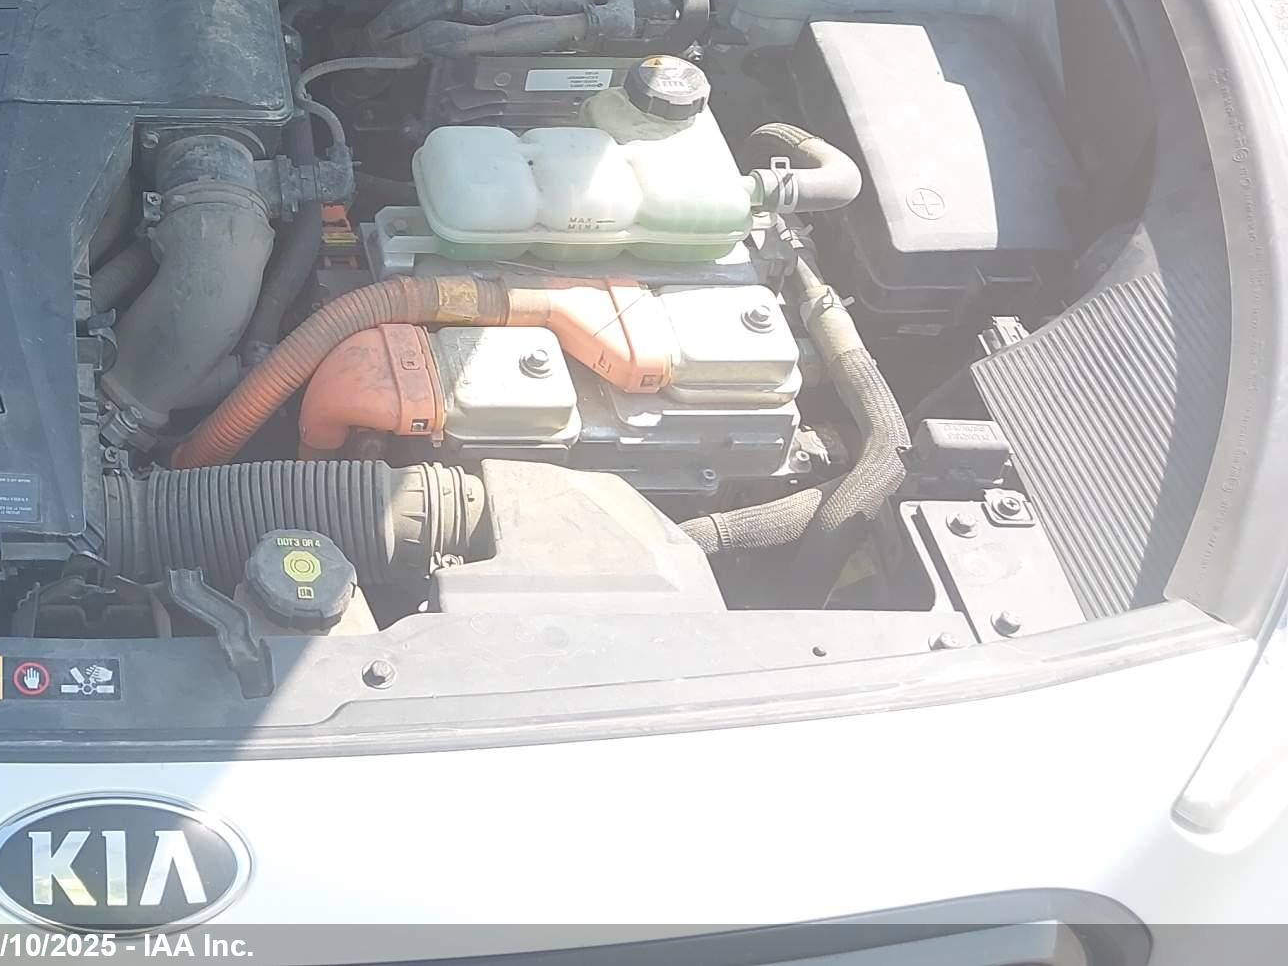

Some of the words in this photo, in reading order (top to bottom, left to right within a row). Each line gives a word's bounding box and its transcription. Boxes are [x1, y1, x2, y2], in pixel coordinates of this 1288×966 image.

[276, 537, 300, 547] DOT3
[301, 538, 314, 547] OR
[28, 830, 208, 906] KIA
